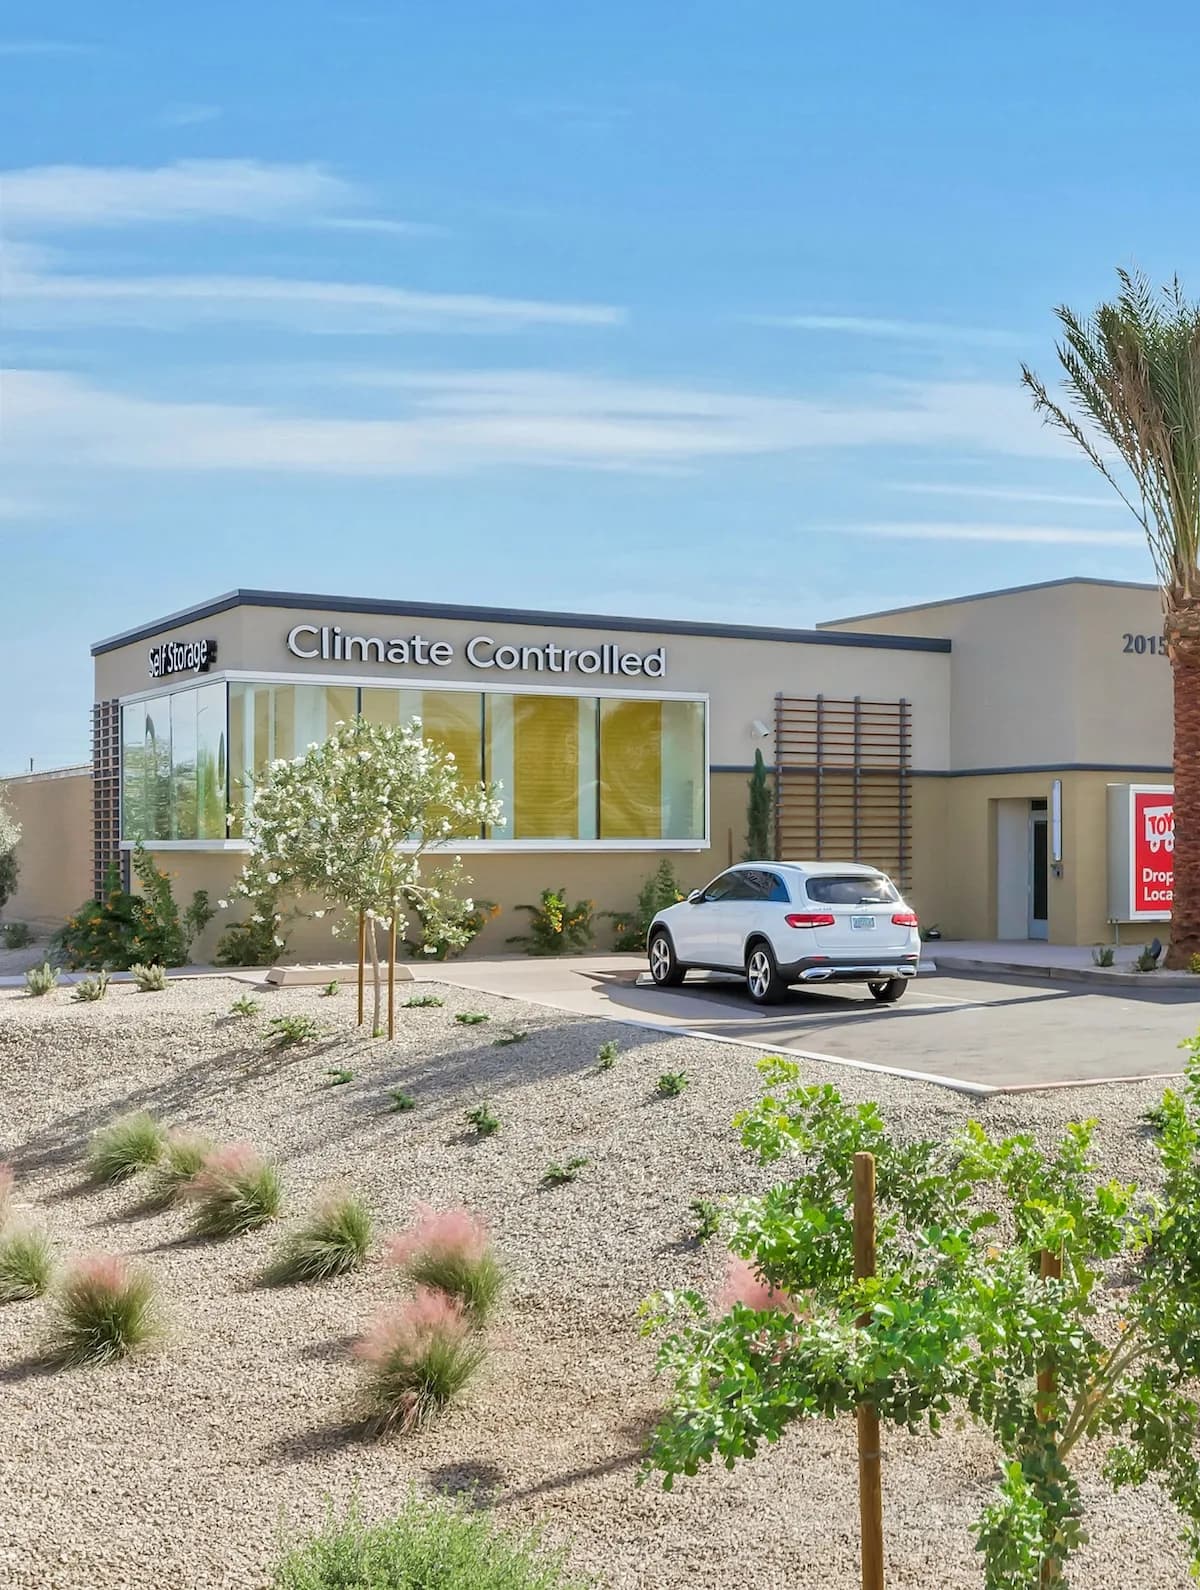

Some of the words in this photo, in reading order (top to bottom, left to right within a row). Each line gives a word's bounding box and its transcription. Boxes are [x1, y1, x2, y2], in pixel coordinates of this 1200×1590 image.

[287, 624, 453, 666] Climate
[466, 636, 666, 677] Controlled
[1122, 633, 1167, 655] 2015
[149, 643, 166, 677] Self
[167, 640, 208, 672] Storage
[1148, 812, 1174, 836] TOY
[1142, 867, 1174, 887] Drop
[1143, 886, 1174, 902] Loca
